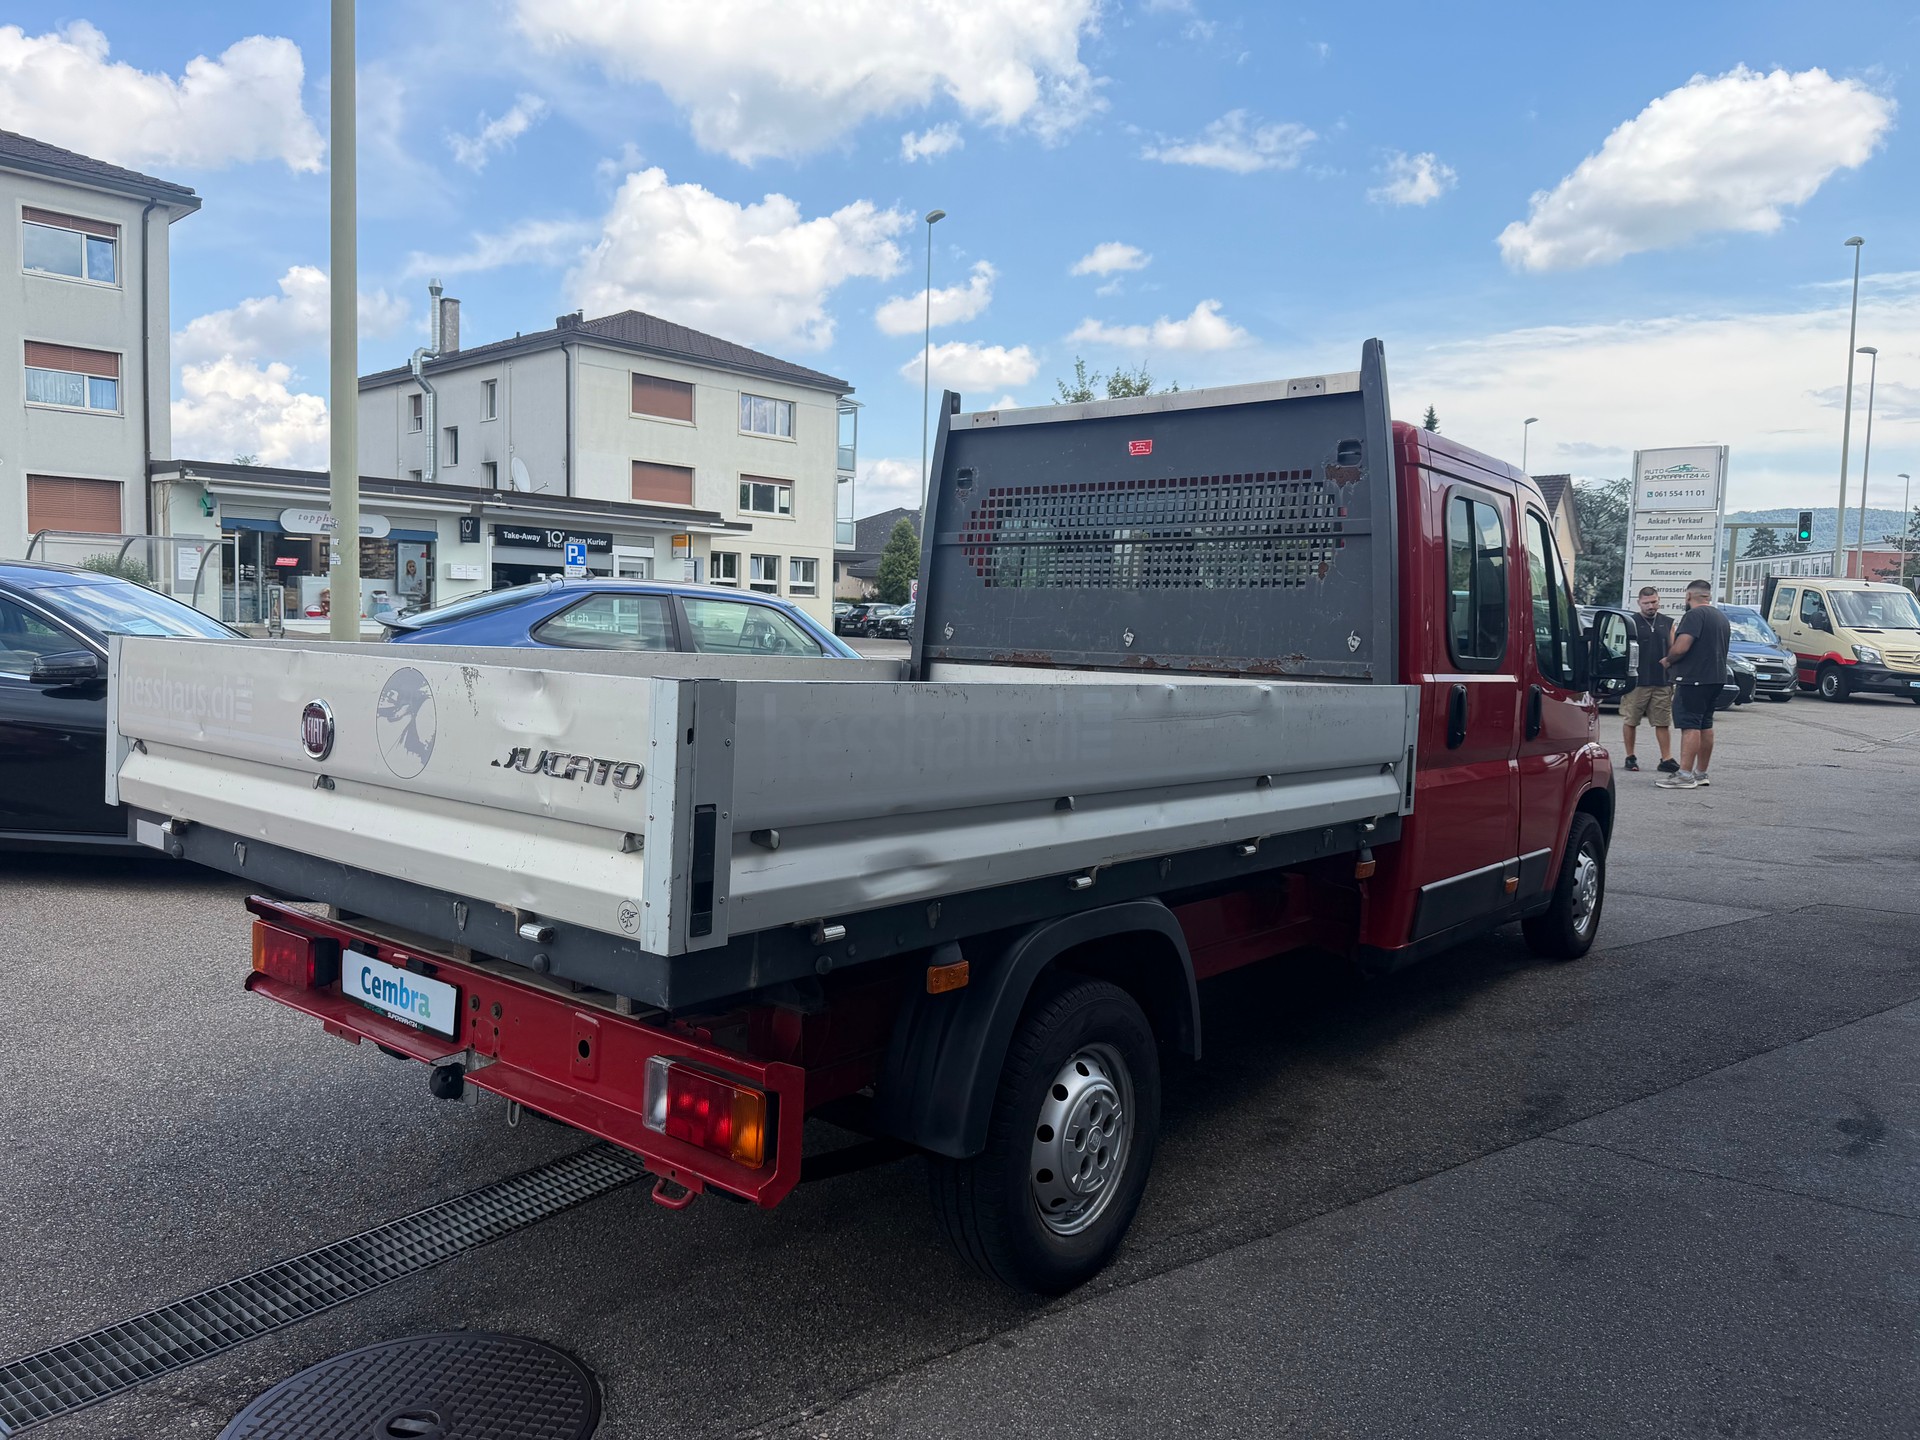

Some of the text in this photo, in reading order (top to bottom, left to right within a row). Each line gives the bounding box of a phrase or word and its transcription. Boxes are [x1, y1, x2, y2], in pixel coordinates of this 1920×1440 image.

[298, 514, 330, 524] topph
[503, 531, 541, 542] Take-Away
[568, 545, 578, 562] P
[1672, 603, 1686, 611] Felg
[124, 662, 234, 720] hesshaus.ch
[307, 716, 326, 744] FIAT
[361, 966, 430, 1018] Cembra
